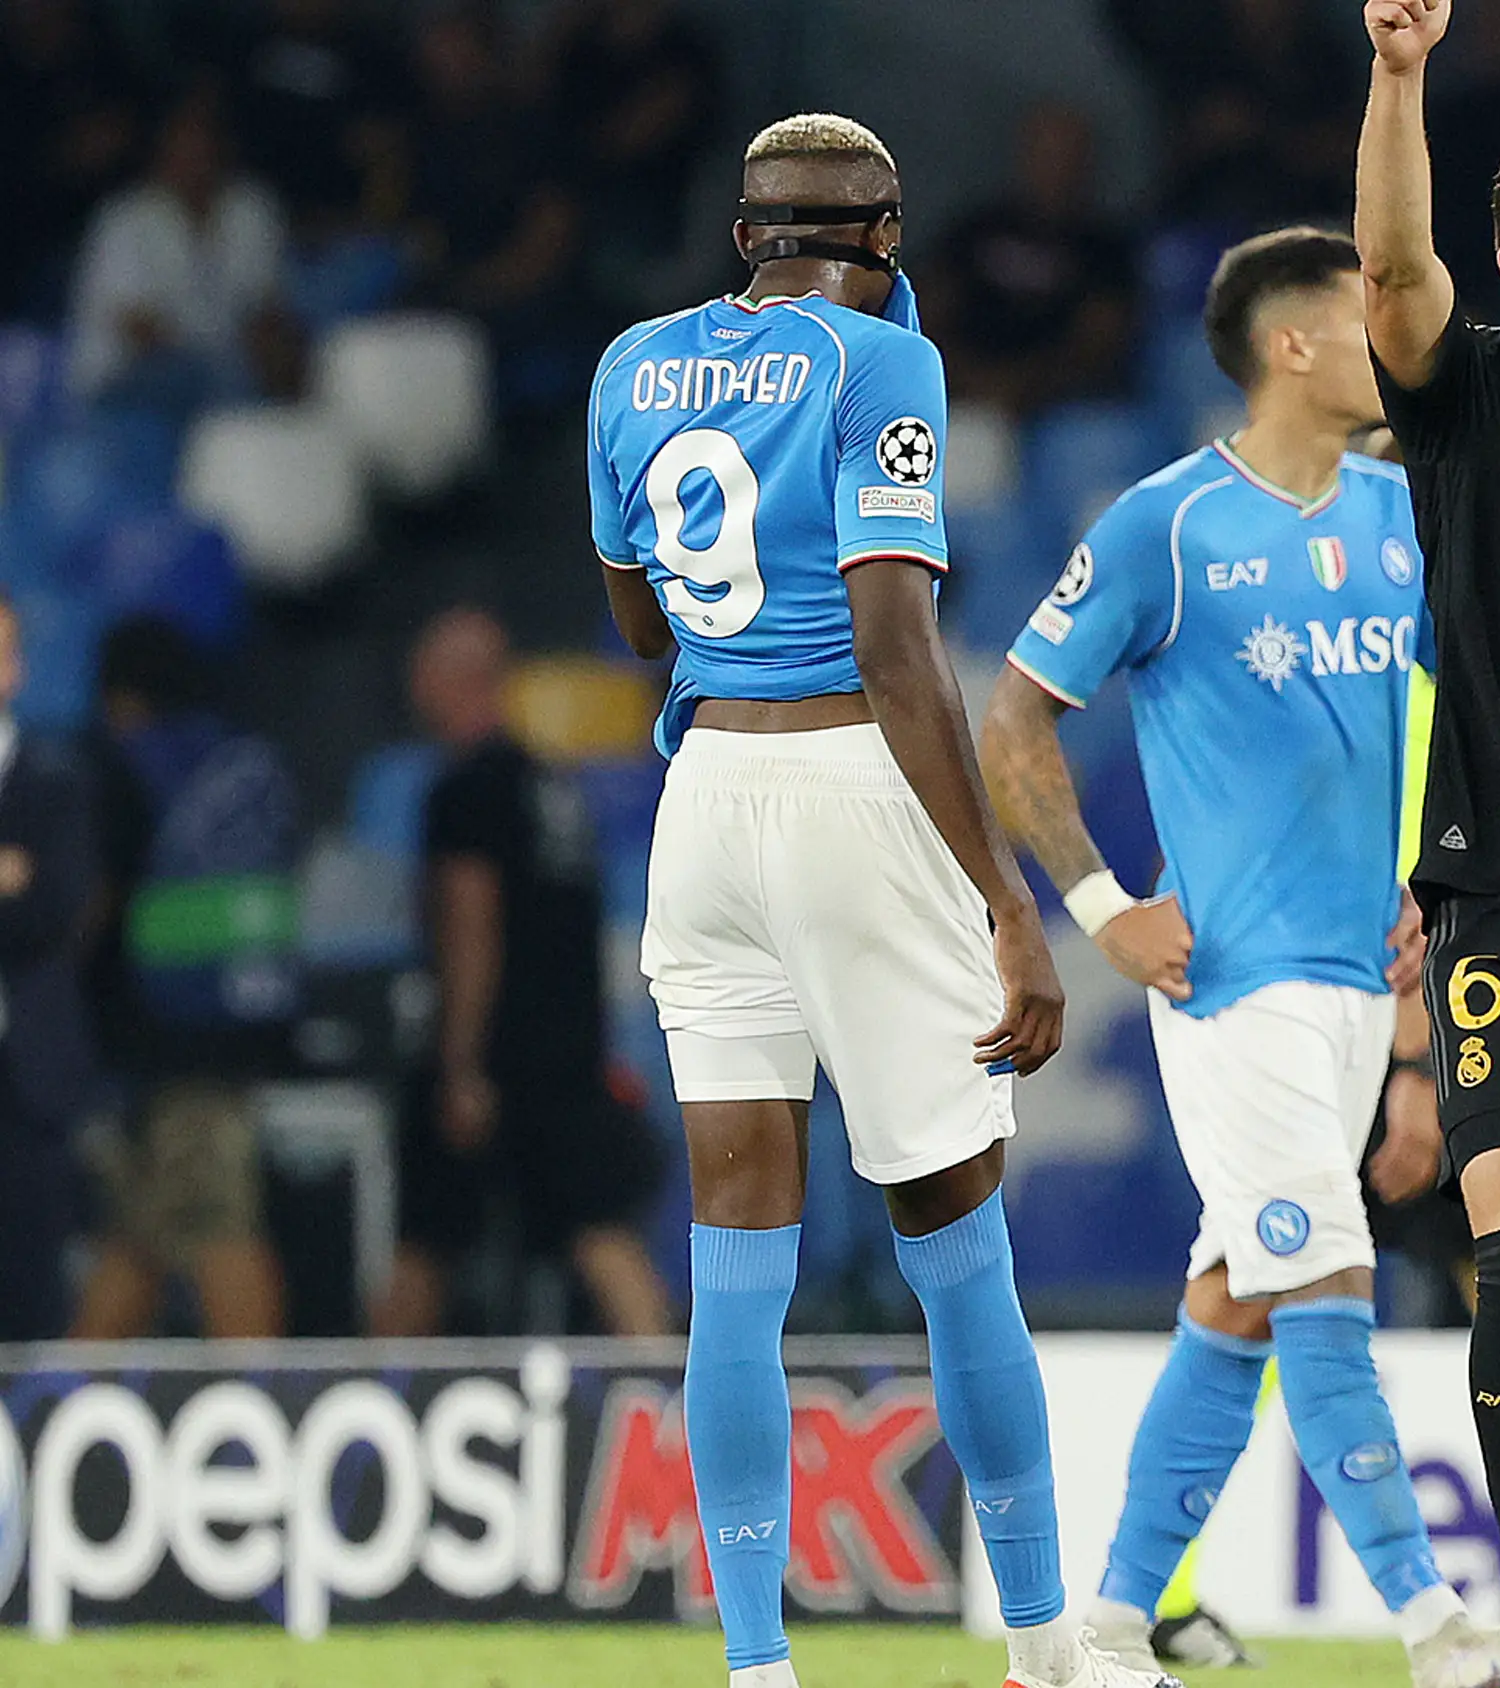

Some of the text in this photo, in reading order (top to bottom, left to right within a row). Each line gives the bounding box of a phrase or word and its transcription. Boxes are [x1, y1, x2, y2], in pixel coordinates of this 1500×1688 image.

[645, 428, 765, 638] 9
[1206, 557, 1269, 591] EA7
[28, 1341, 952, 1642] pepsi MX
[975, 1497, 1014, 1515] A7
[718, 1519, 777, 1546] EA7
